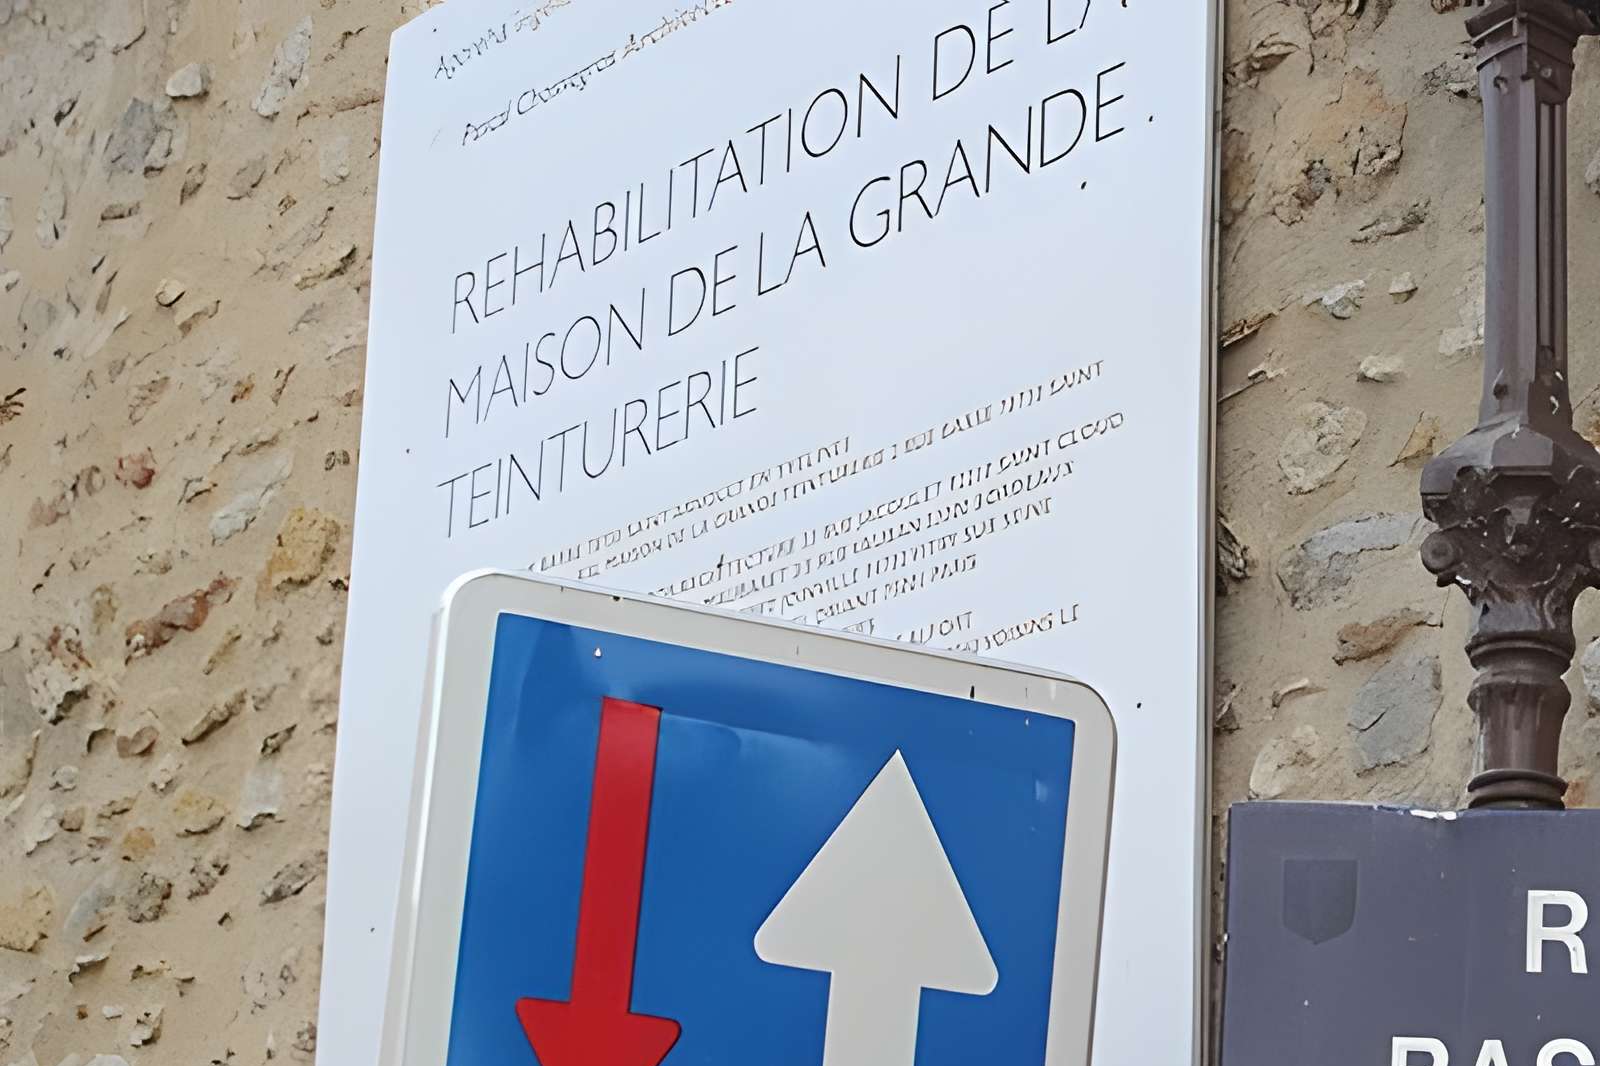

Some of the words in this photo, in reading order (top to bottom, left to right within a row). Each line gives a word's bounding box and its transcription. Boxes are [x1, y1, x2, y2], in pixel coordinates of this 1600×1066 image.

[445, 287, 646, 439] MAISON
[668, 244, 739, 336] DE
[758, 210, 826, 296] LA
[849, 61, 1126, 247] GRANDE
[452, 54, 900, 334] REHABILITATION
[932, 0, 1014, 101] DE
[435, 346, 760, 539] TEINTURERIE
